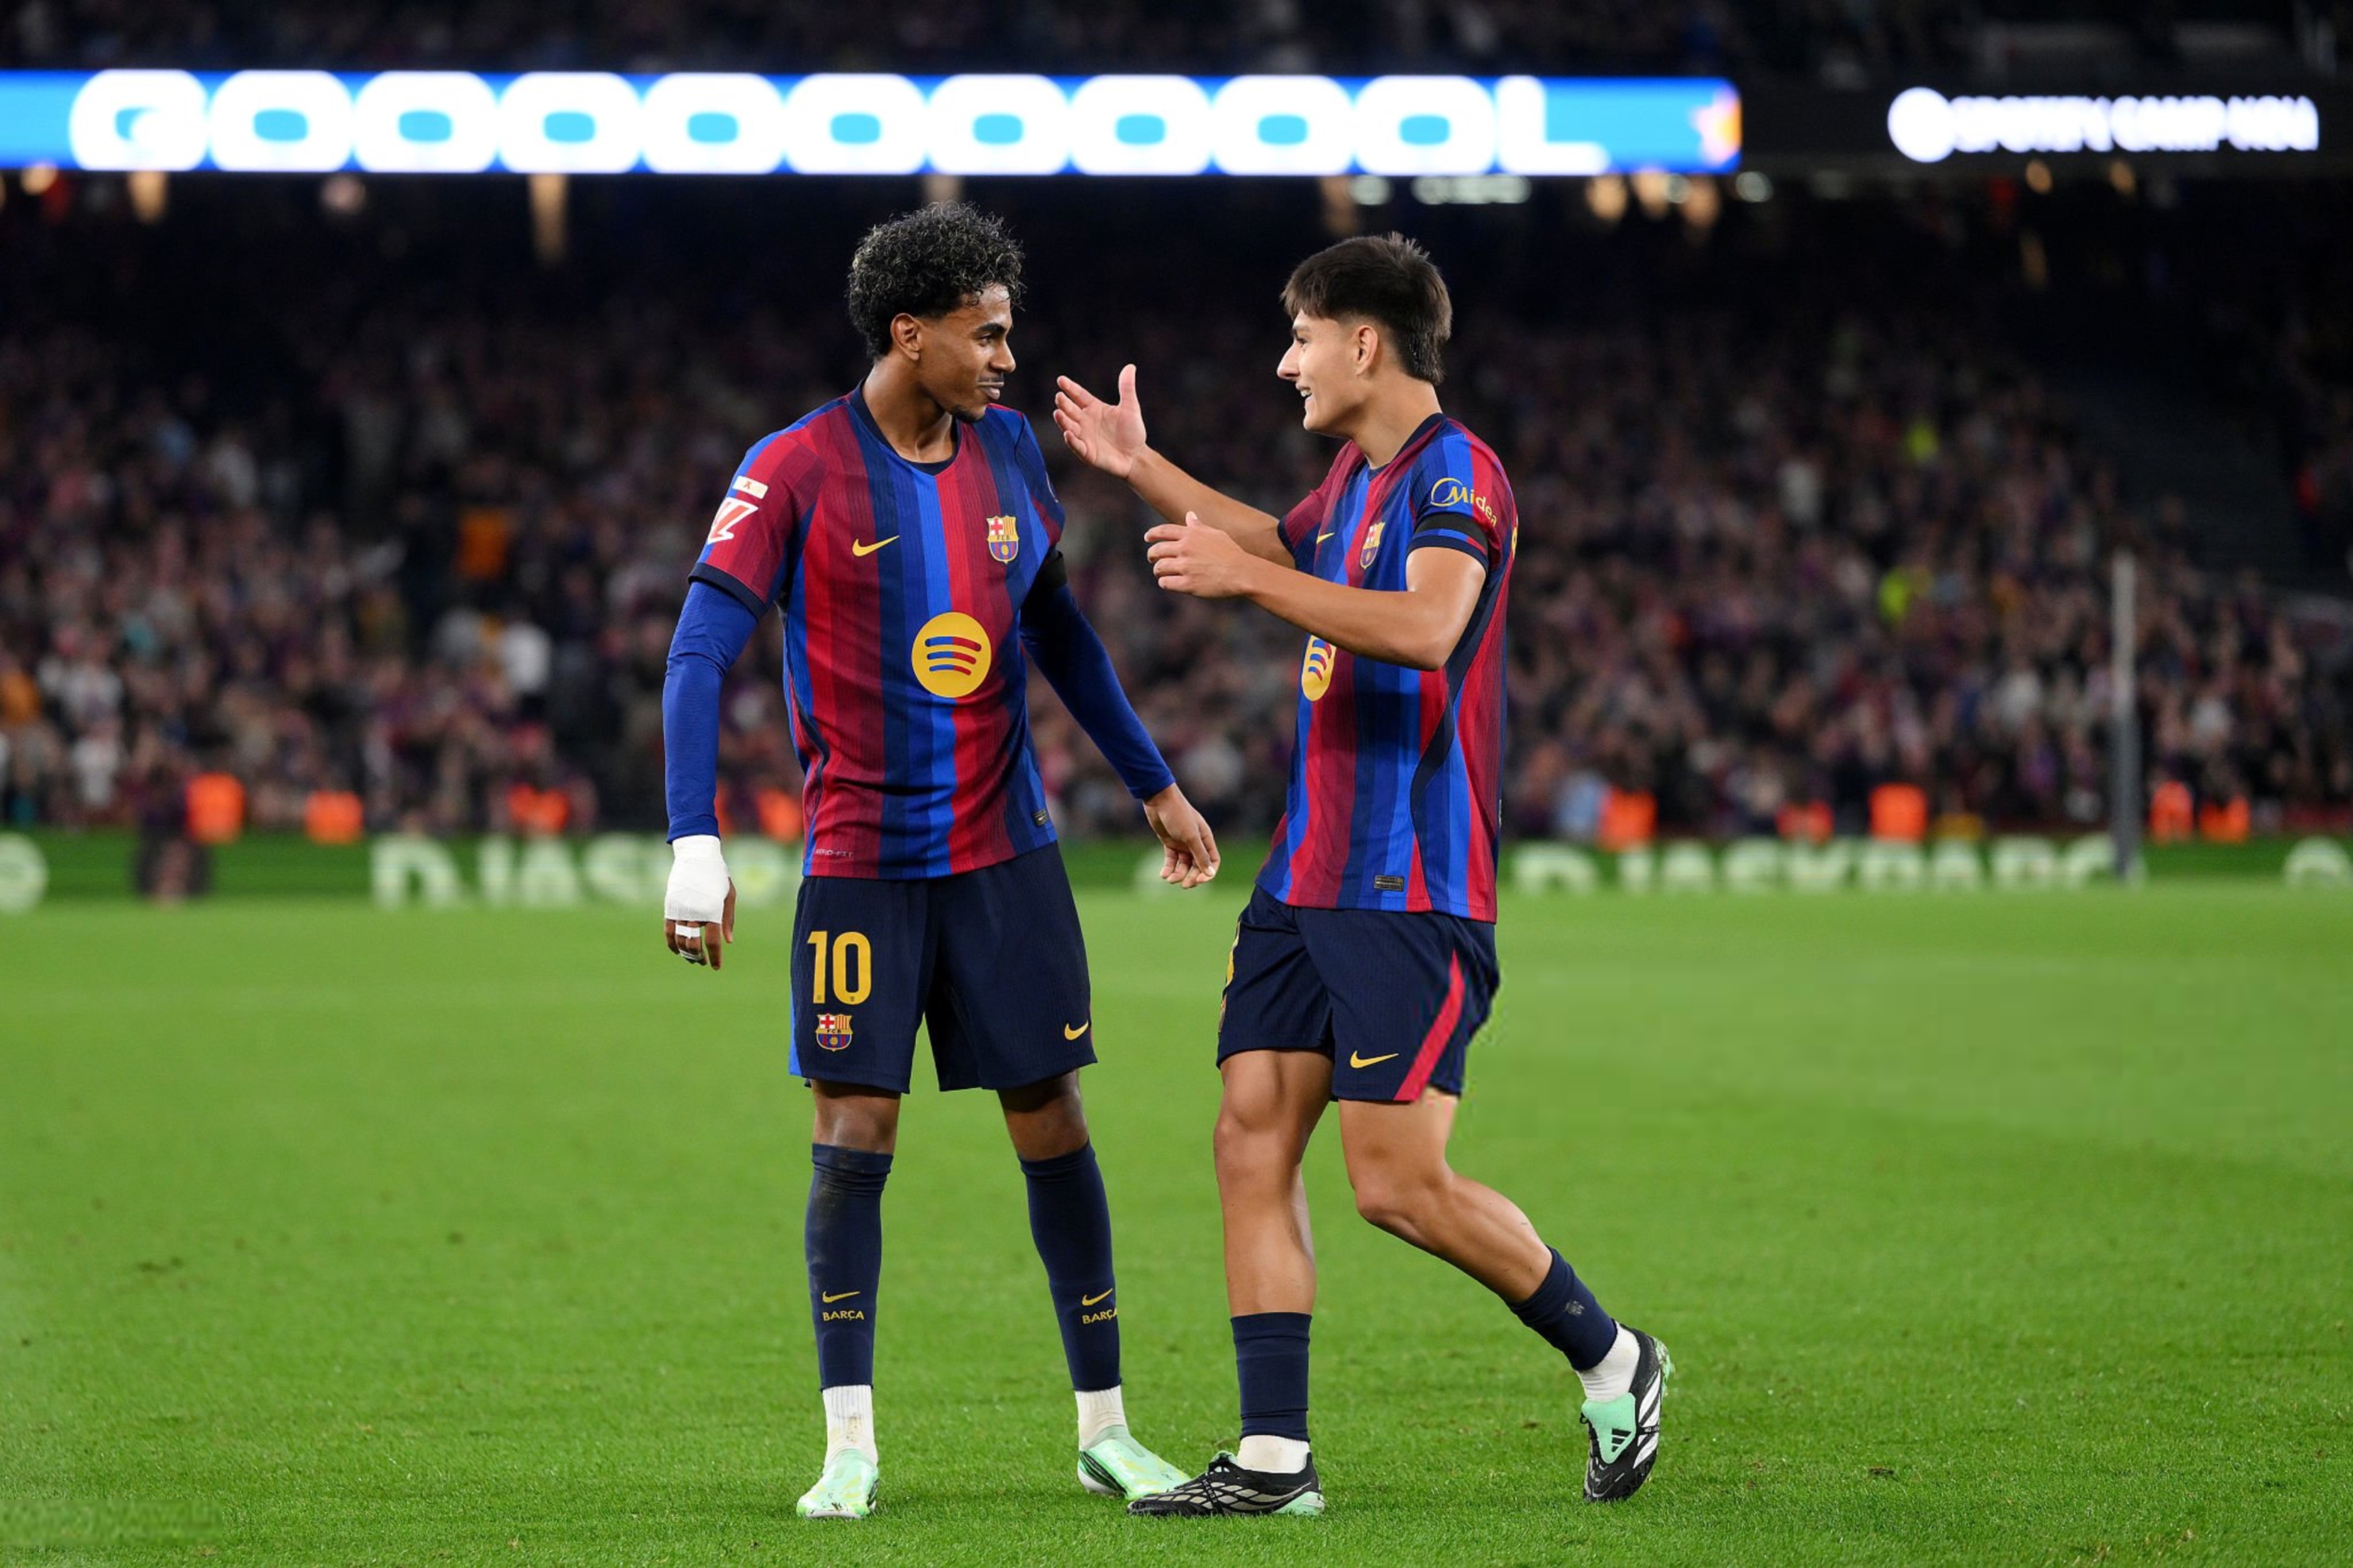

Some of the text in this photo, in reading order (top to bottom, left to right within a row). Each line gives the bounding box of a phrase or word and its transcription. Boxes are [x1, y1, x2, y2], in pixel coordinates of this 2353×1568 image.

[68, 68, 1610, 176] GOOOOOOOOOL
[1430, 477, 1497, 527] Midea
[807, 930, 871, 1005] 10
[822, 1310, 865, 1322] BARÇA
